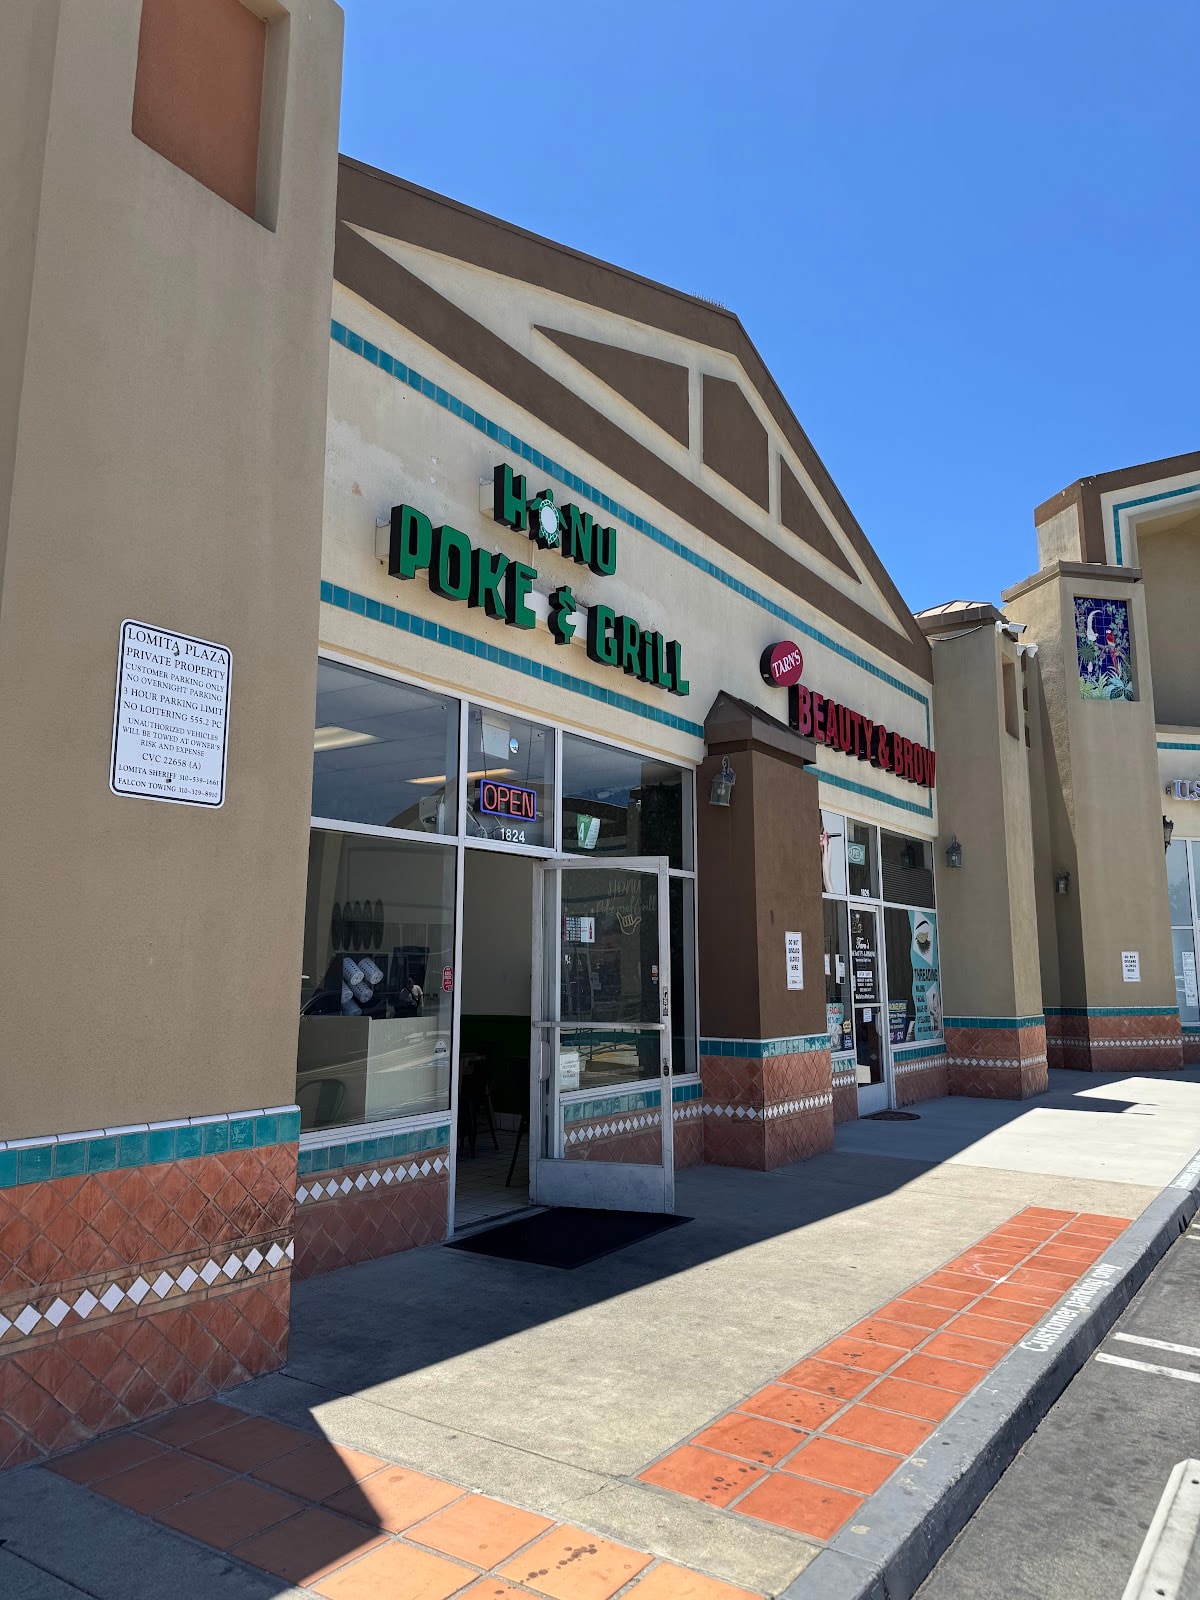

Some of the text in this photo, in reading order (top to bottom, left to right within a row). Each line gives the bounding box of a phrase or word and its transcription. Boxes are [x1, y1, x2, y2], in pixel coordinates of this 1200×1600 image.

[494, 463, 617, 577] HONU
[389, 504, 537, 630] POKE
[548, 585, 577, 645] &
[128, 628, 226, 664] LOMITA PLAZA
[125, 662, 225, 693] CUSTOMER PARKING ONLY
[126, 647, 225, 680] PRIVATE PROPERTY
[772, 649, 801, 678] TARN'S
[123, 687, 223, 715] 3 HOUR PARKING LIMIT
[127, 673, 222, 702] NO OVERNIGHT PARKING
[123, 701, 222, 728] NO LOITERING 555.2 PC
[128, 717, 219, 741] UNAUTHORIZED VEHICLES
[122, 725, 220, 750] WILL BE TOWED AT OWNER'S
[140, 739, 205, 757] RISK AND EXPENSE
[789, 684, 936, 788] BEAUTY & BROW
[118, 764, 147, 775] LOMITA
[148, 769, 178, 780] SHERIFF
[142, 752, 201, 770] CVC 22658 (A)
[118, 777, 146, 788] FALCON
[148, 782, 176, 793] TOWING
[483, 784, 534, 818] OPEN
[500, 827, 526, 843] 1824
[1019, 1263, 1123, 1352] Customer parking only
